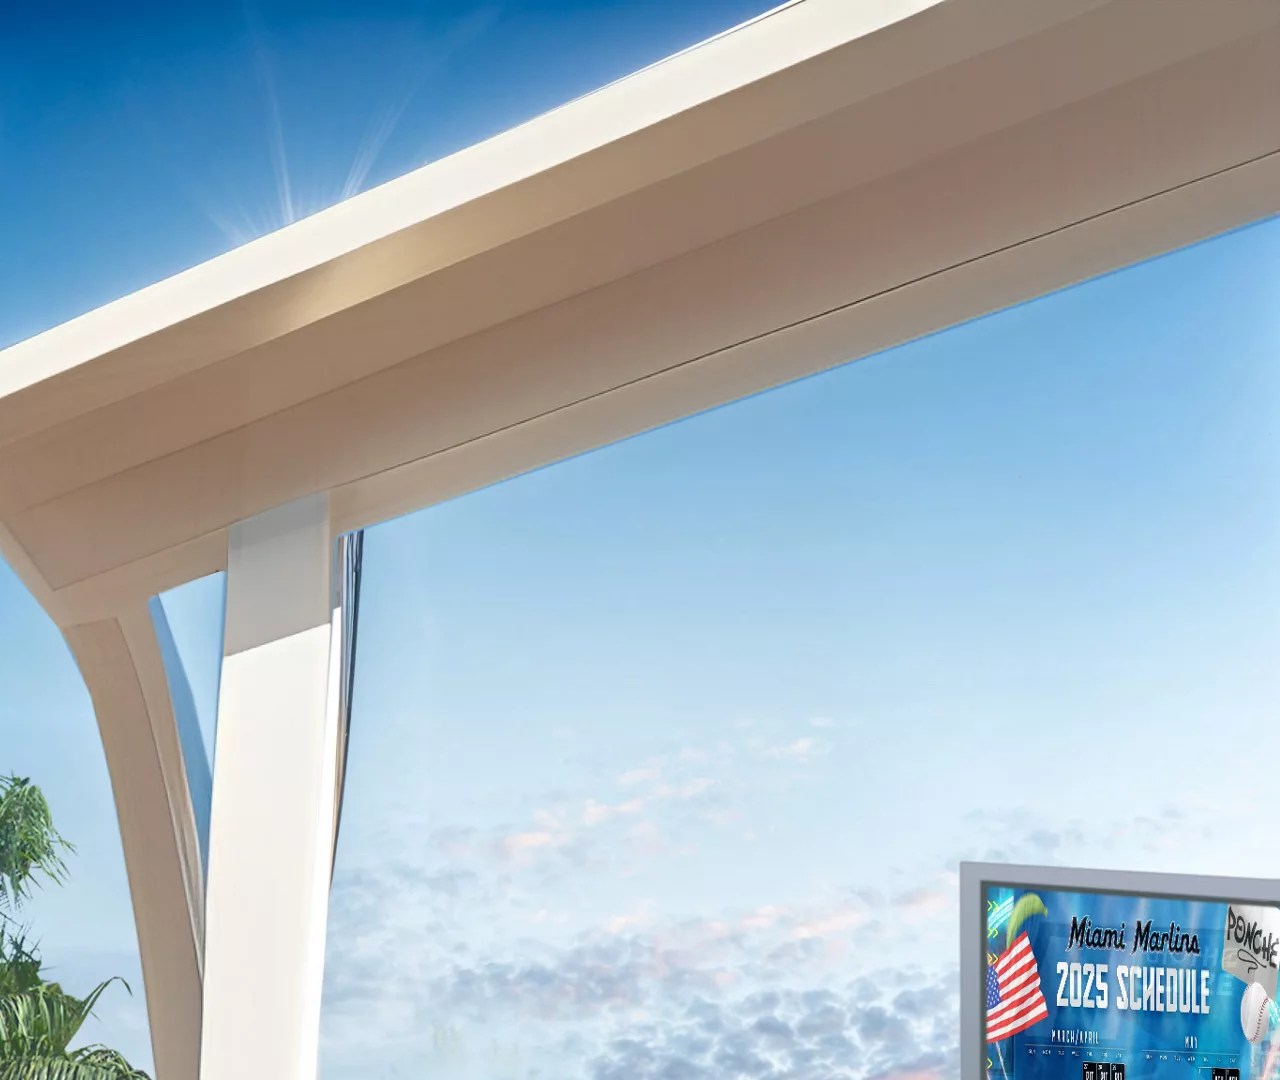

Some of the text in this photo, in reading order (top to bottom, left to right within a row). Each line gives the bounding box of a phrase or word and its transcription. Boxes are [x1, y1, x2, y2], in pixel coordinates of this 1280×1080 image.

[1065, 915, 1200, 954] Miami Marlins
[1056, 961, 1108, 1008] 2025
[1116, 965, 1210, 1014] SCHEDULE
